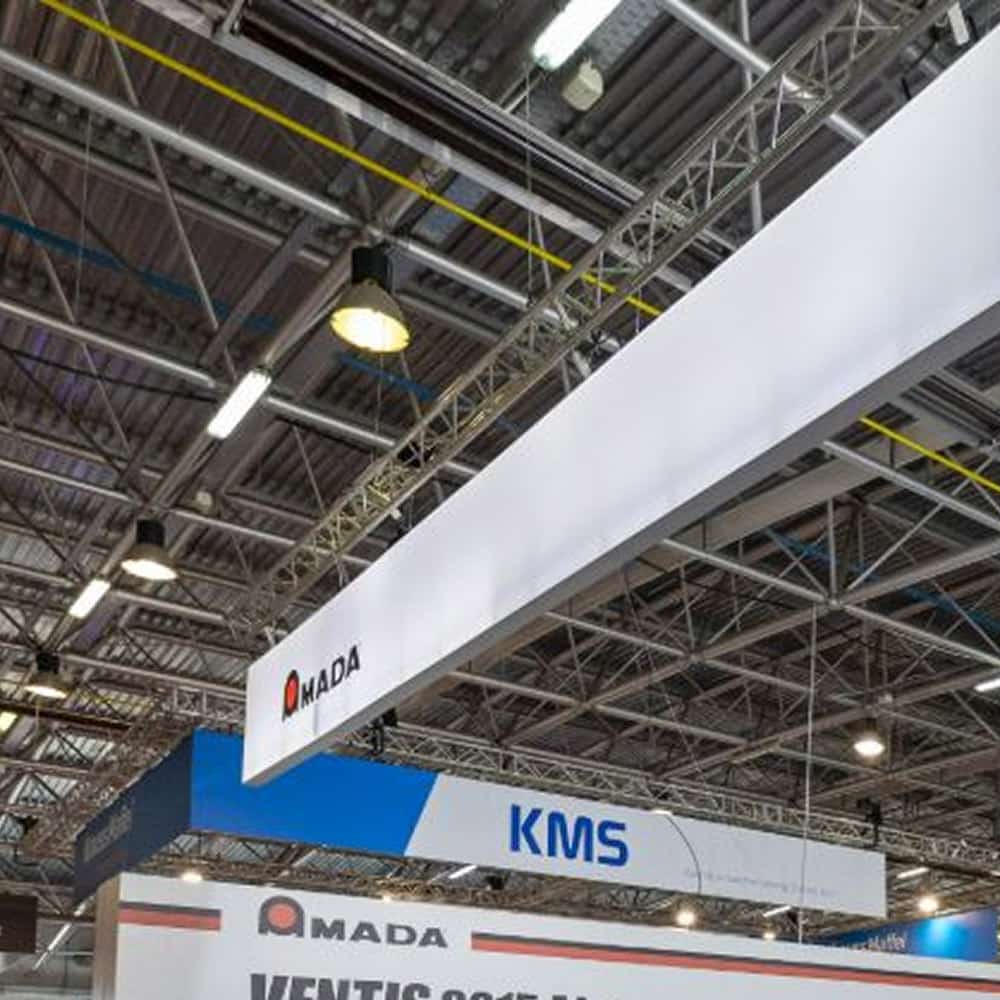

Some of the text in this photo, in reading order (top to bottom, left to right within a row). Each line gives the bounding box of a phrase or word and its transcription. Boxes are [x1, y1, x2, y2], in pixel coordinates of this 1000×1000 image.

[282, 644, 360, 722] AMADA
[510, 803, 629, 867] KMS
[258, 895, 449, 948] AMADA
